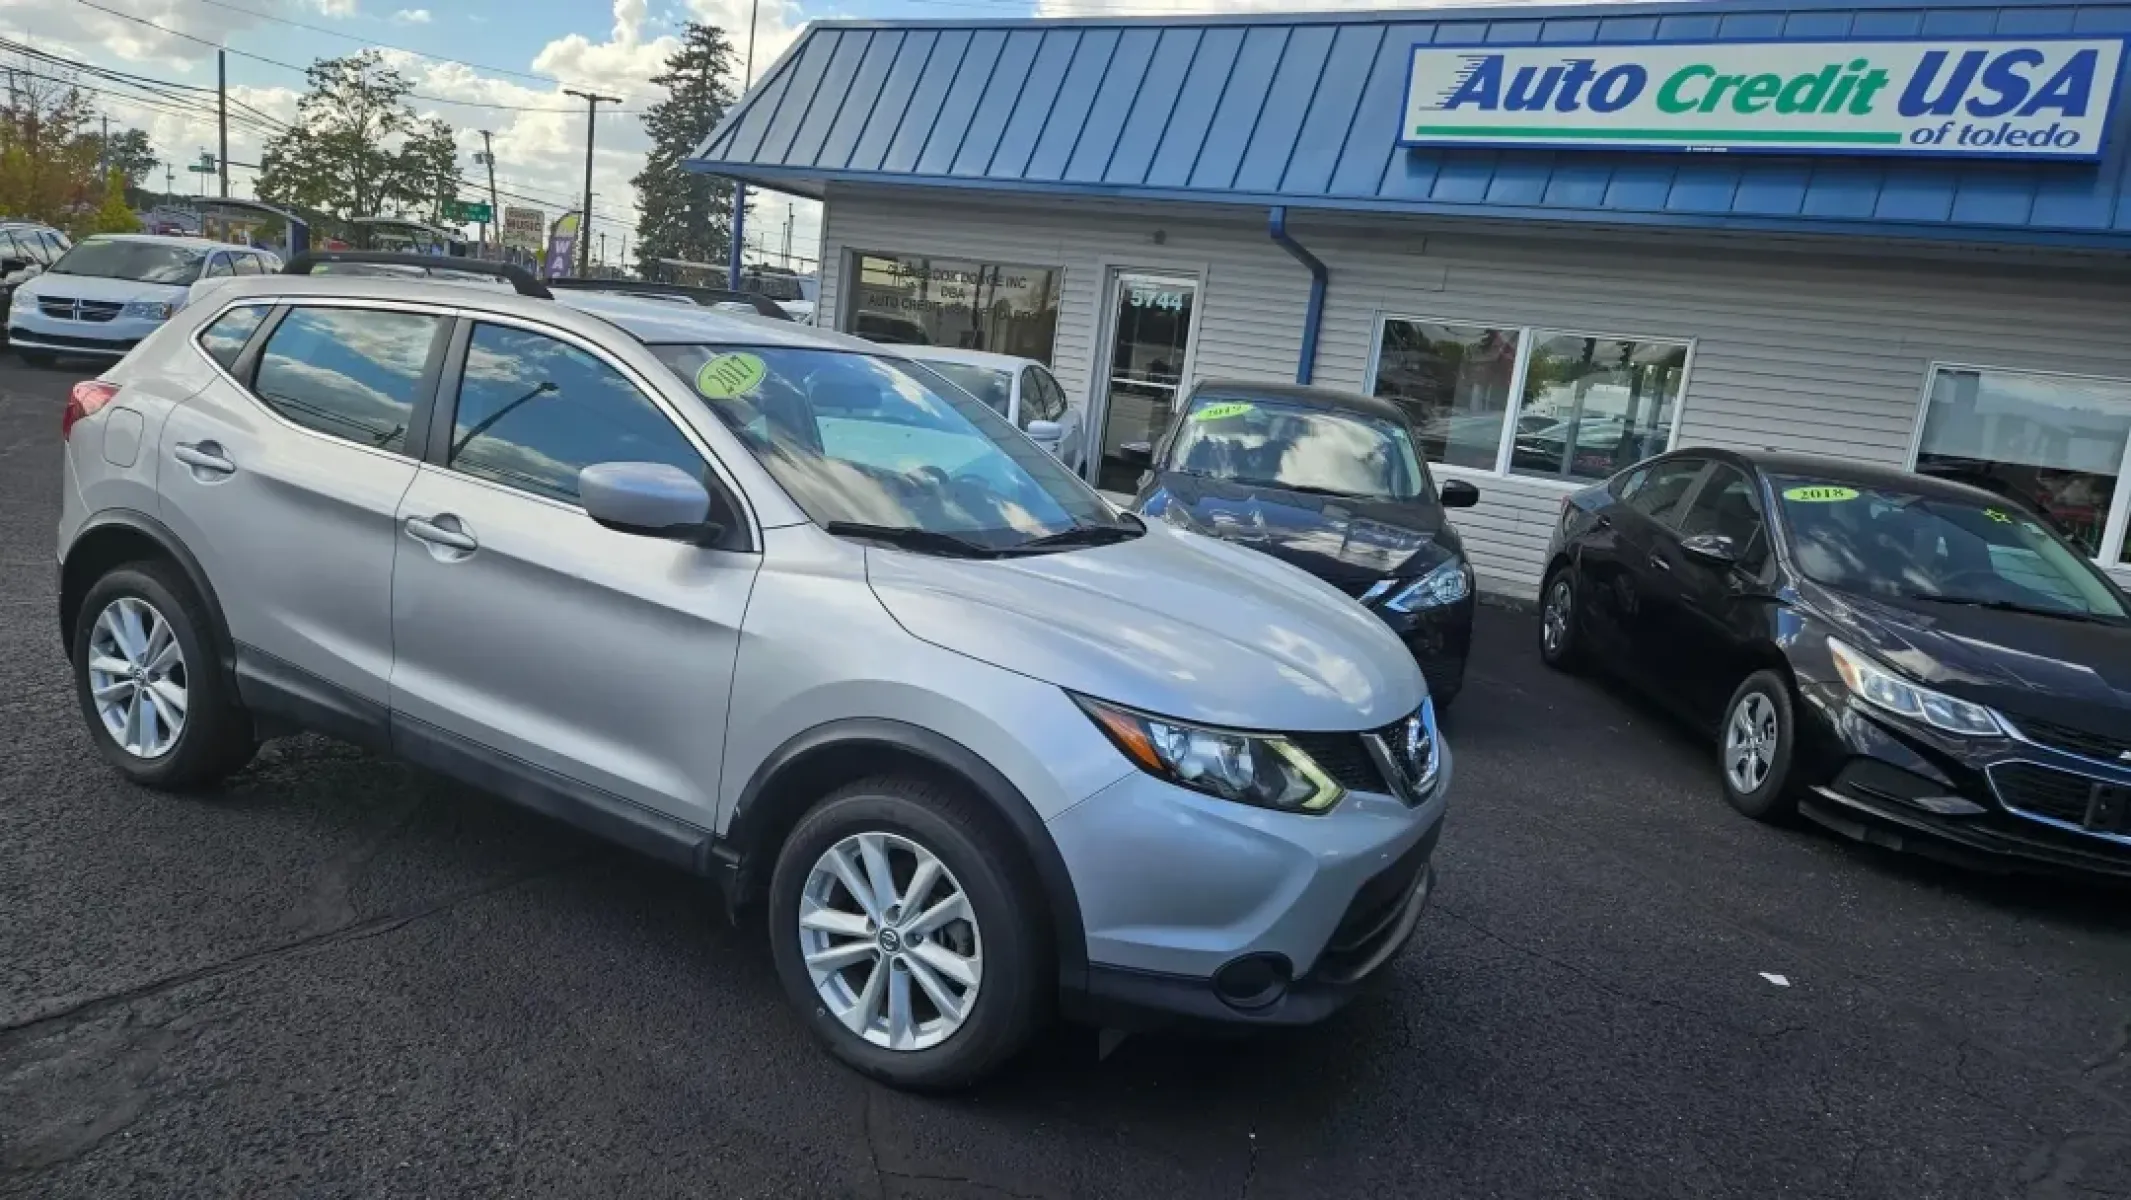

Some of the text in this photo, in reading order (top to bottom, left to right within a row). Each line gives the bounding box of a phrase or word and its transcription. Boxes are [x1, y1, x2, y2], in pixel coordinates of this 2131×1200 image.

[1440, 48, 2099, 117] Auto Credit USA
[1909, 120, 2081, 149] of toledo
[506, 218, 542, 232] MUSIC
[869, 293, 898, 308] AUTO
[901, 299, 941, 314] CREDIT
[940, 285, 966, 300] DBA
[1130, 289, 1183, 312] 5744
[708, 354, 755, 395] 2017
[1800, 488, 1844, 500] 2018
